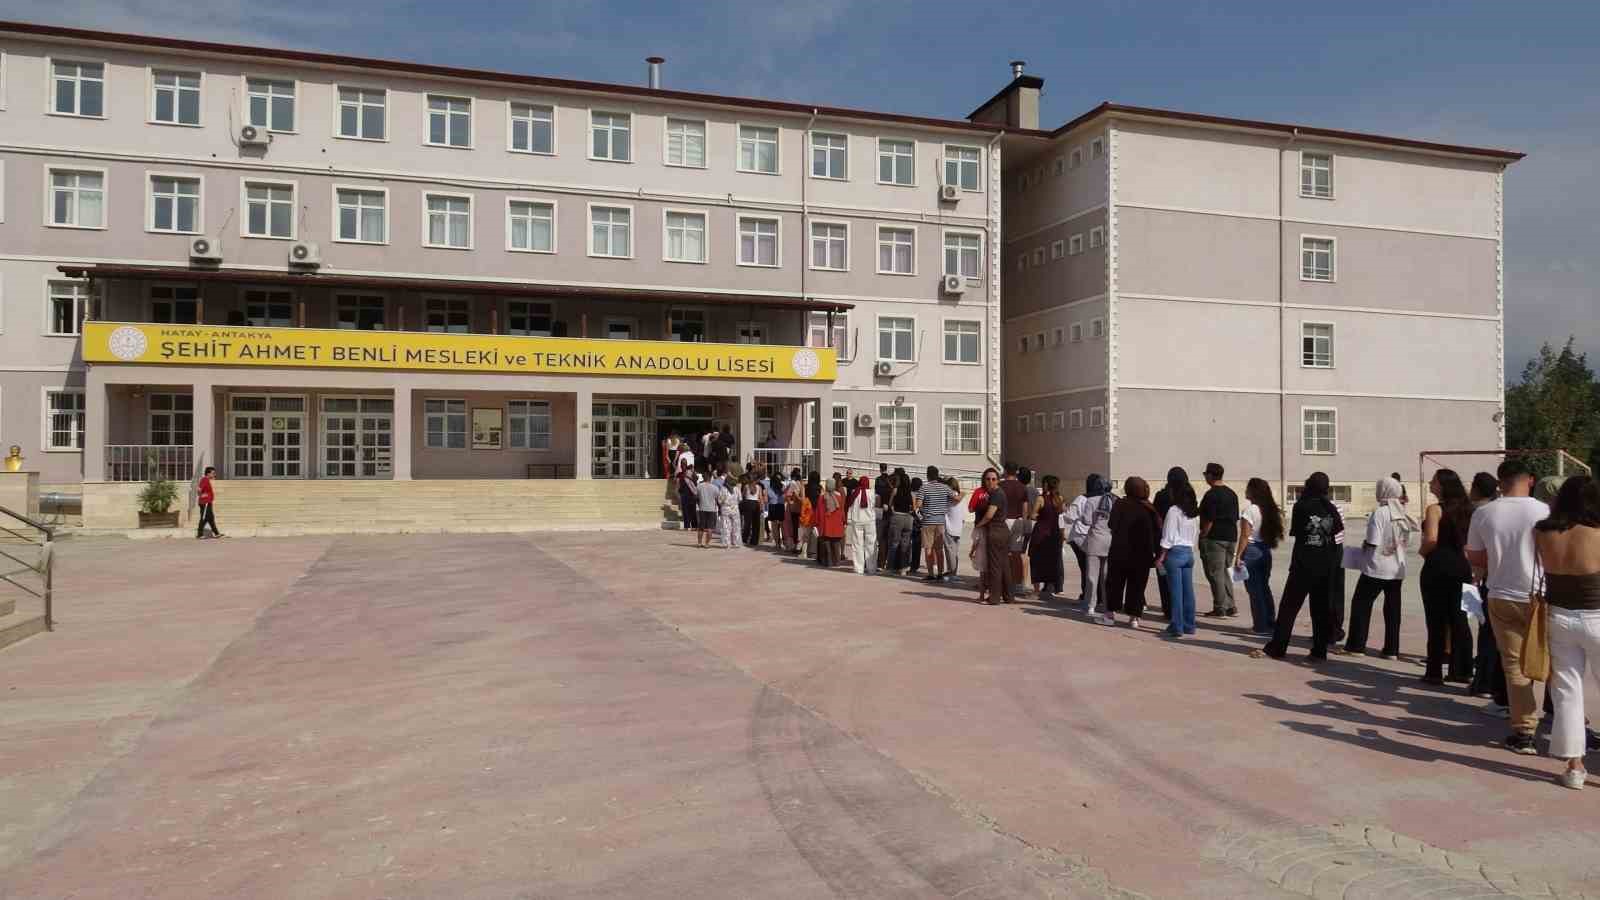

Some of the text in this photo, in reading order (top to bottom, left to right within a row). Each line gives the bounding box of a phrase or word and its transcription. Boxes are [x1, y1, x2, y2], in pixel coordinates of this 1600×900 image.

[161, 340, 775, 374] ŞEHİT AHMET BENLİ MESLEKİ ve TEKNİK ANADOLU LİSESİ
